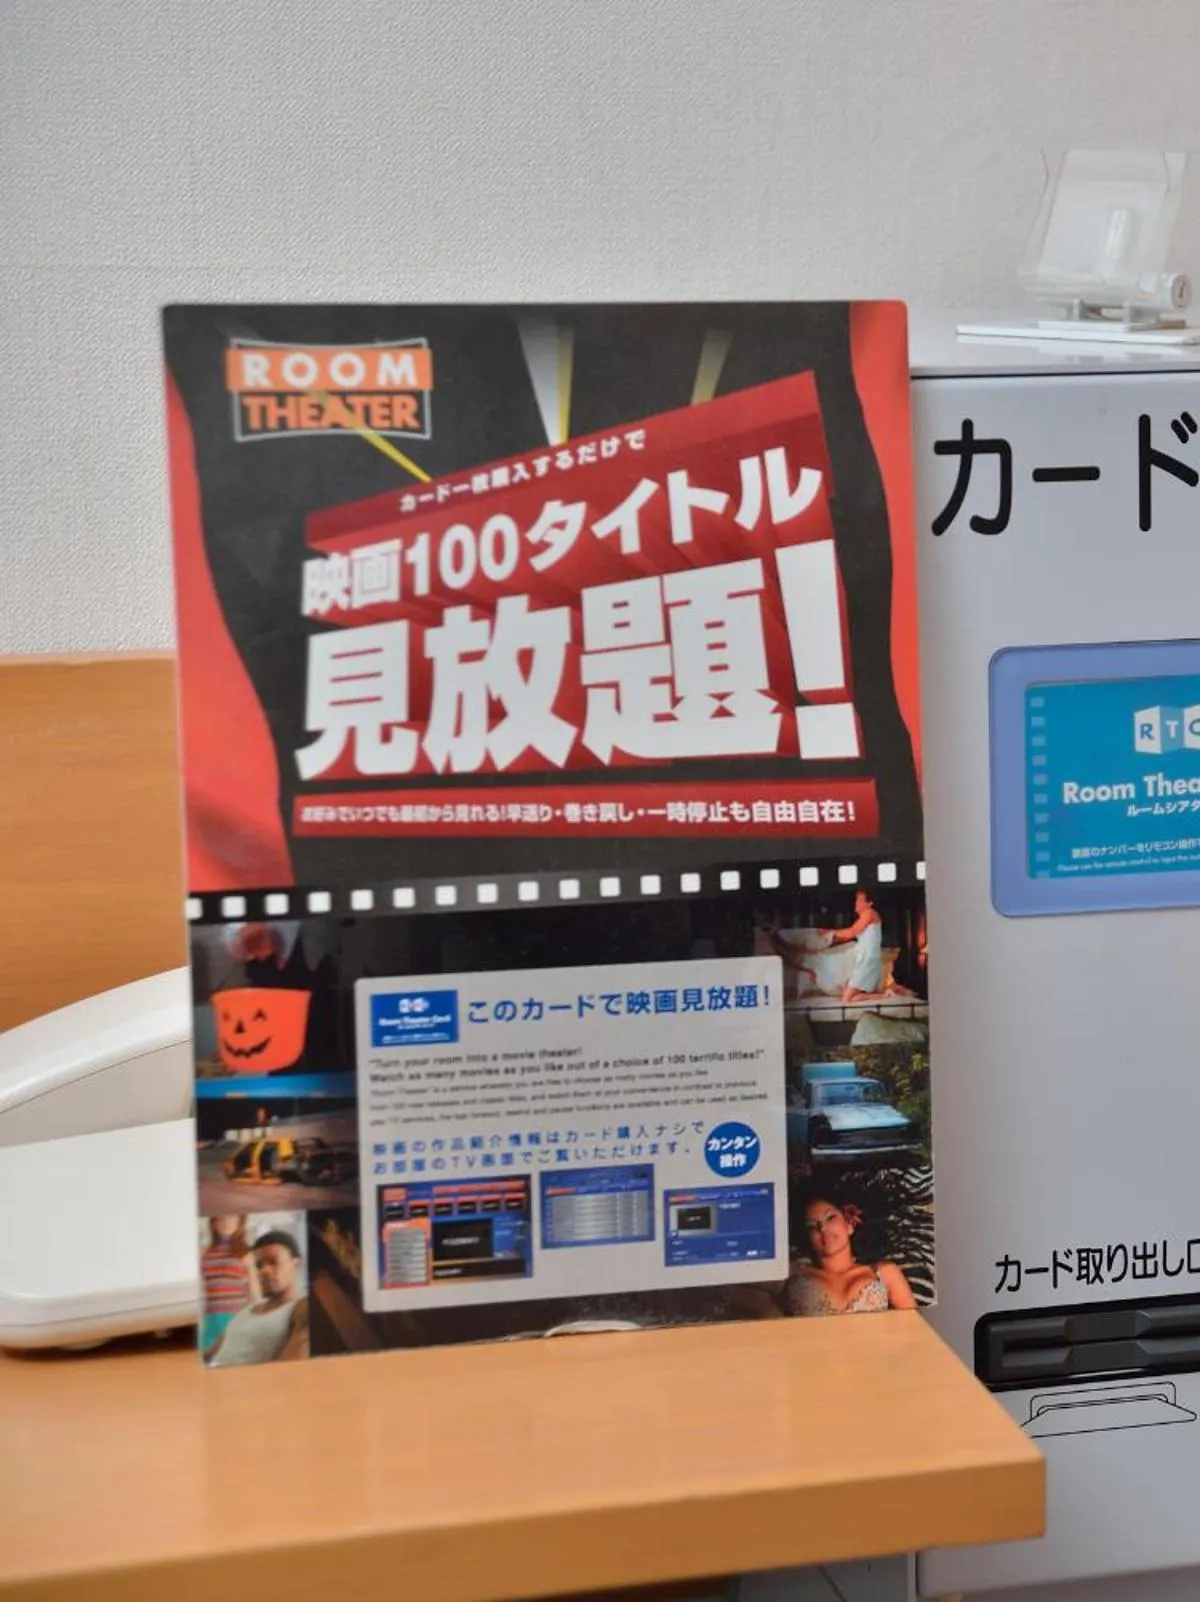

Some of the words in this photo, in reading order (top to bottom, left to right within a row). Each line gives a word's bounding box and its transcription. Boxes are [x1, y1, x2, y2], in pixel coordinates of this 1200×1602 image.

[241, 352, 418, 388] ROOM
[242, 395, 421, 430] THEATER
[931, 411, 1199, 537] カード
[301, 446, 825, 616] 映画100タイトル
[294, 538, 861, 782] 見放題!
[1062, 781, 1136, 805] Room
[467, 984, 770, 1024] このカードで映画見放題!
[707, 1136, 758, 1151] カンタン
[719, 1152, 748, 1169] 操作
